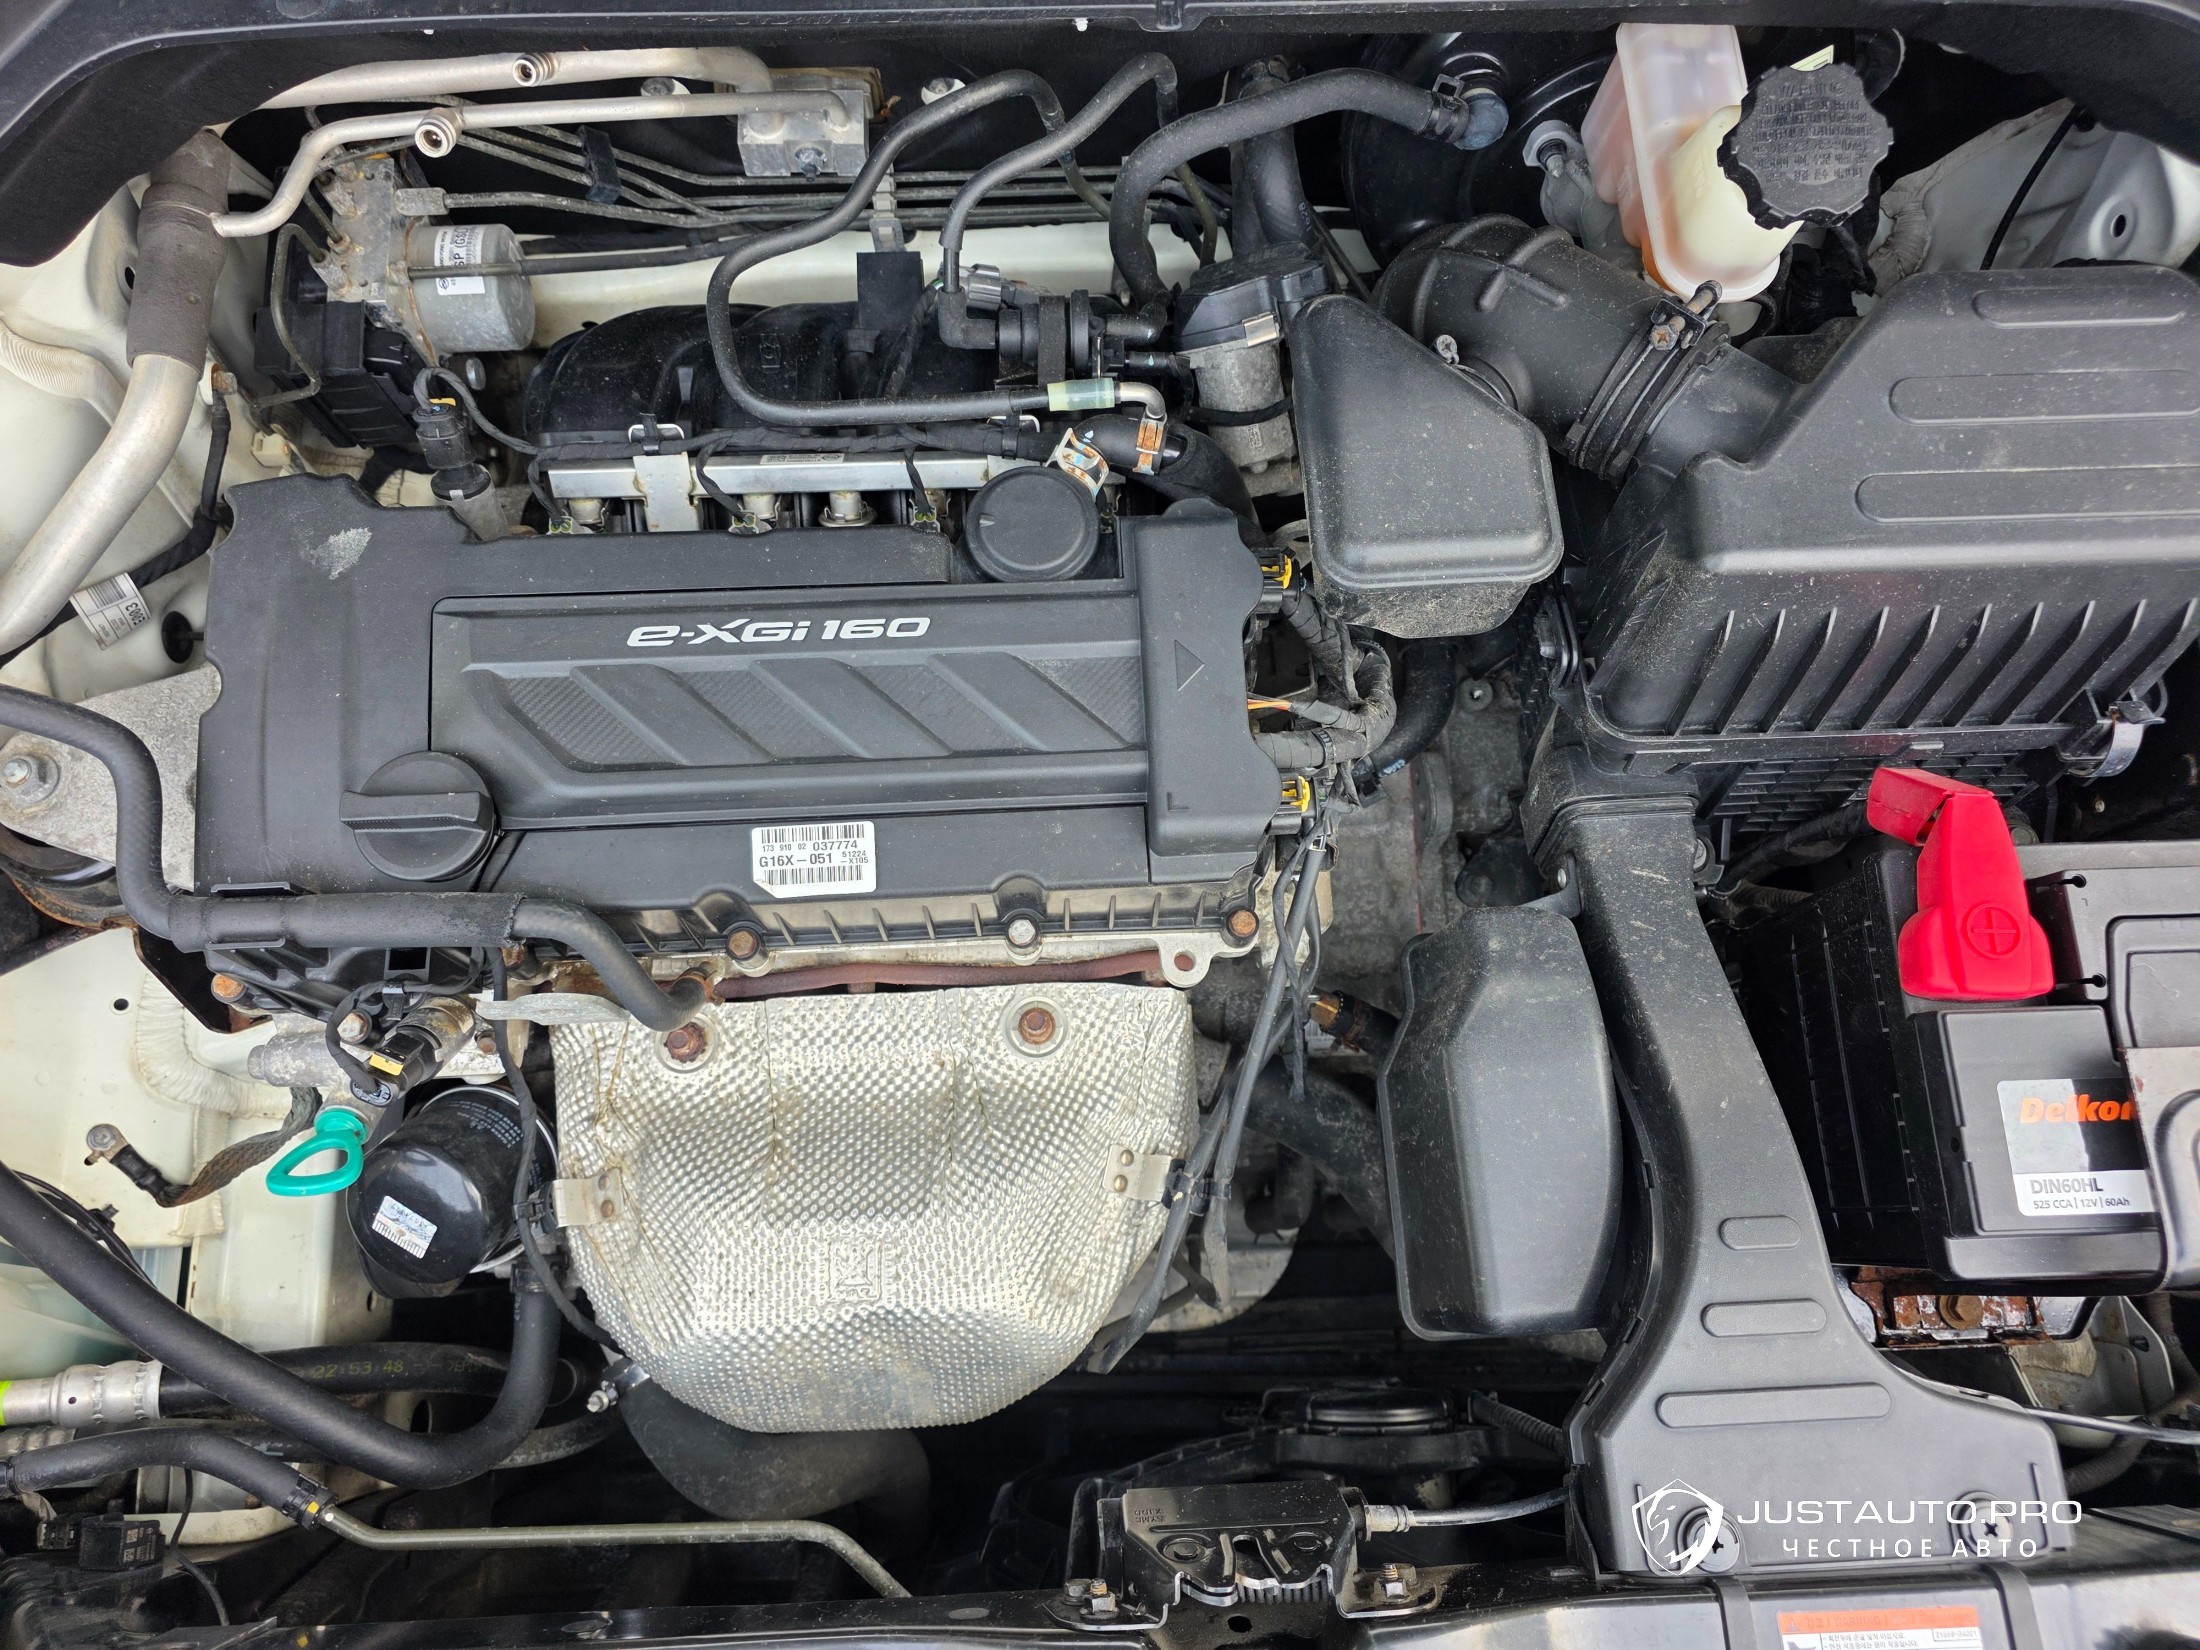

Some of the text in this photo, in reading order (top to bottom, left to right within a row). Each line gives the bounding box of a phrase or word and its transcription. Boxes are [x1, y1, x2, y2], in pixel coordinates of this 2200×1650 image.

[125, 602, 146, 626] E003
[821, 617, 931, 641] 160
[762, 839, 858, 853] 173 910 02 037774
[842, 849, 867, 858] 51224
[2029, 1177, 2104, 1195] DIN60HL
[2033, 1200, 2051, 1210] 525
